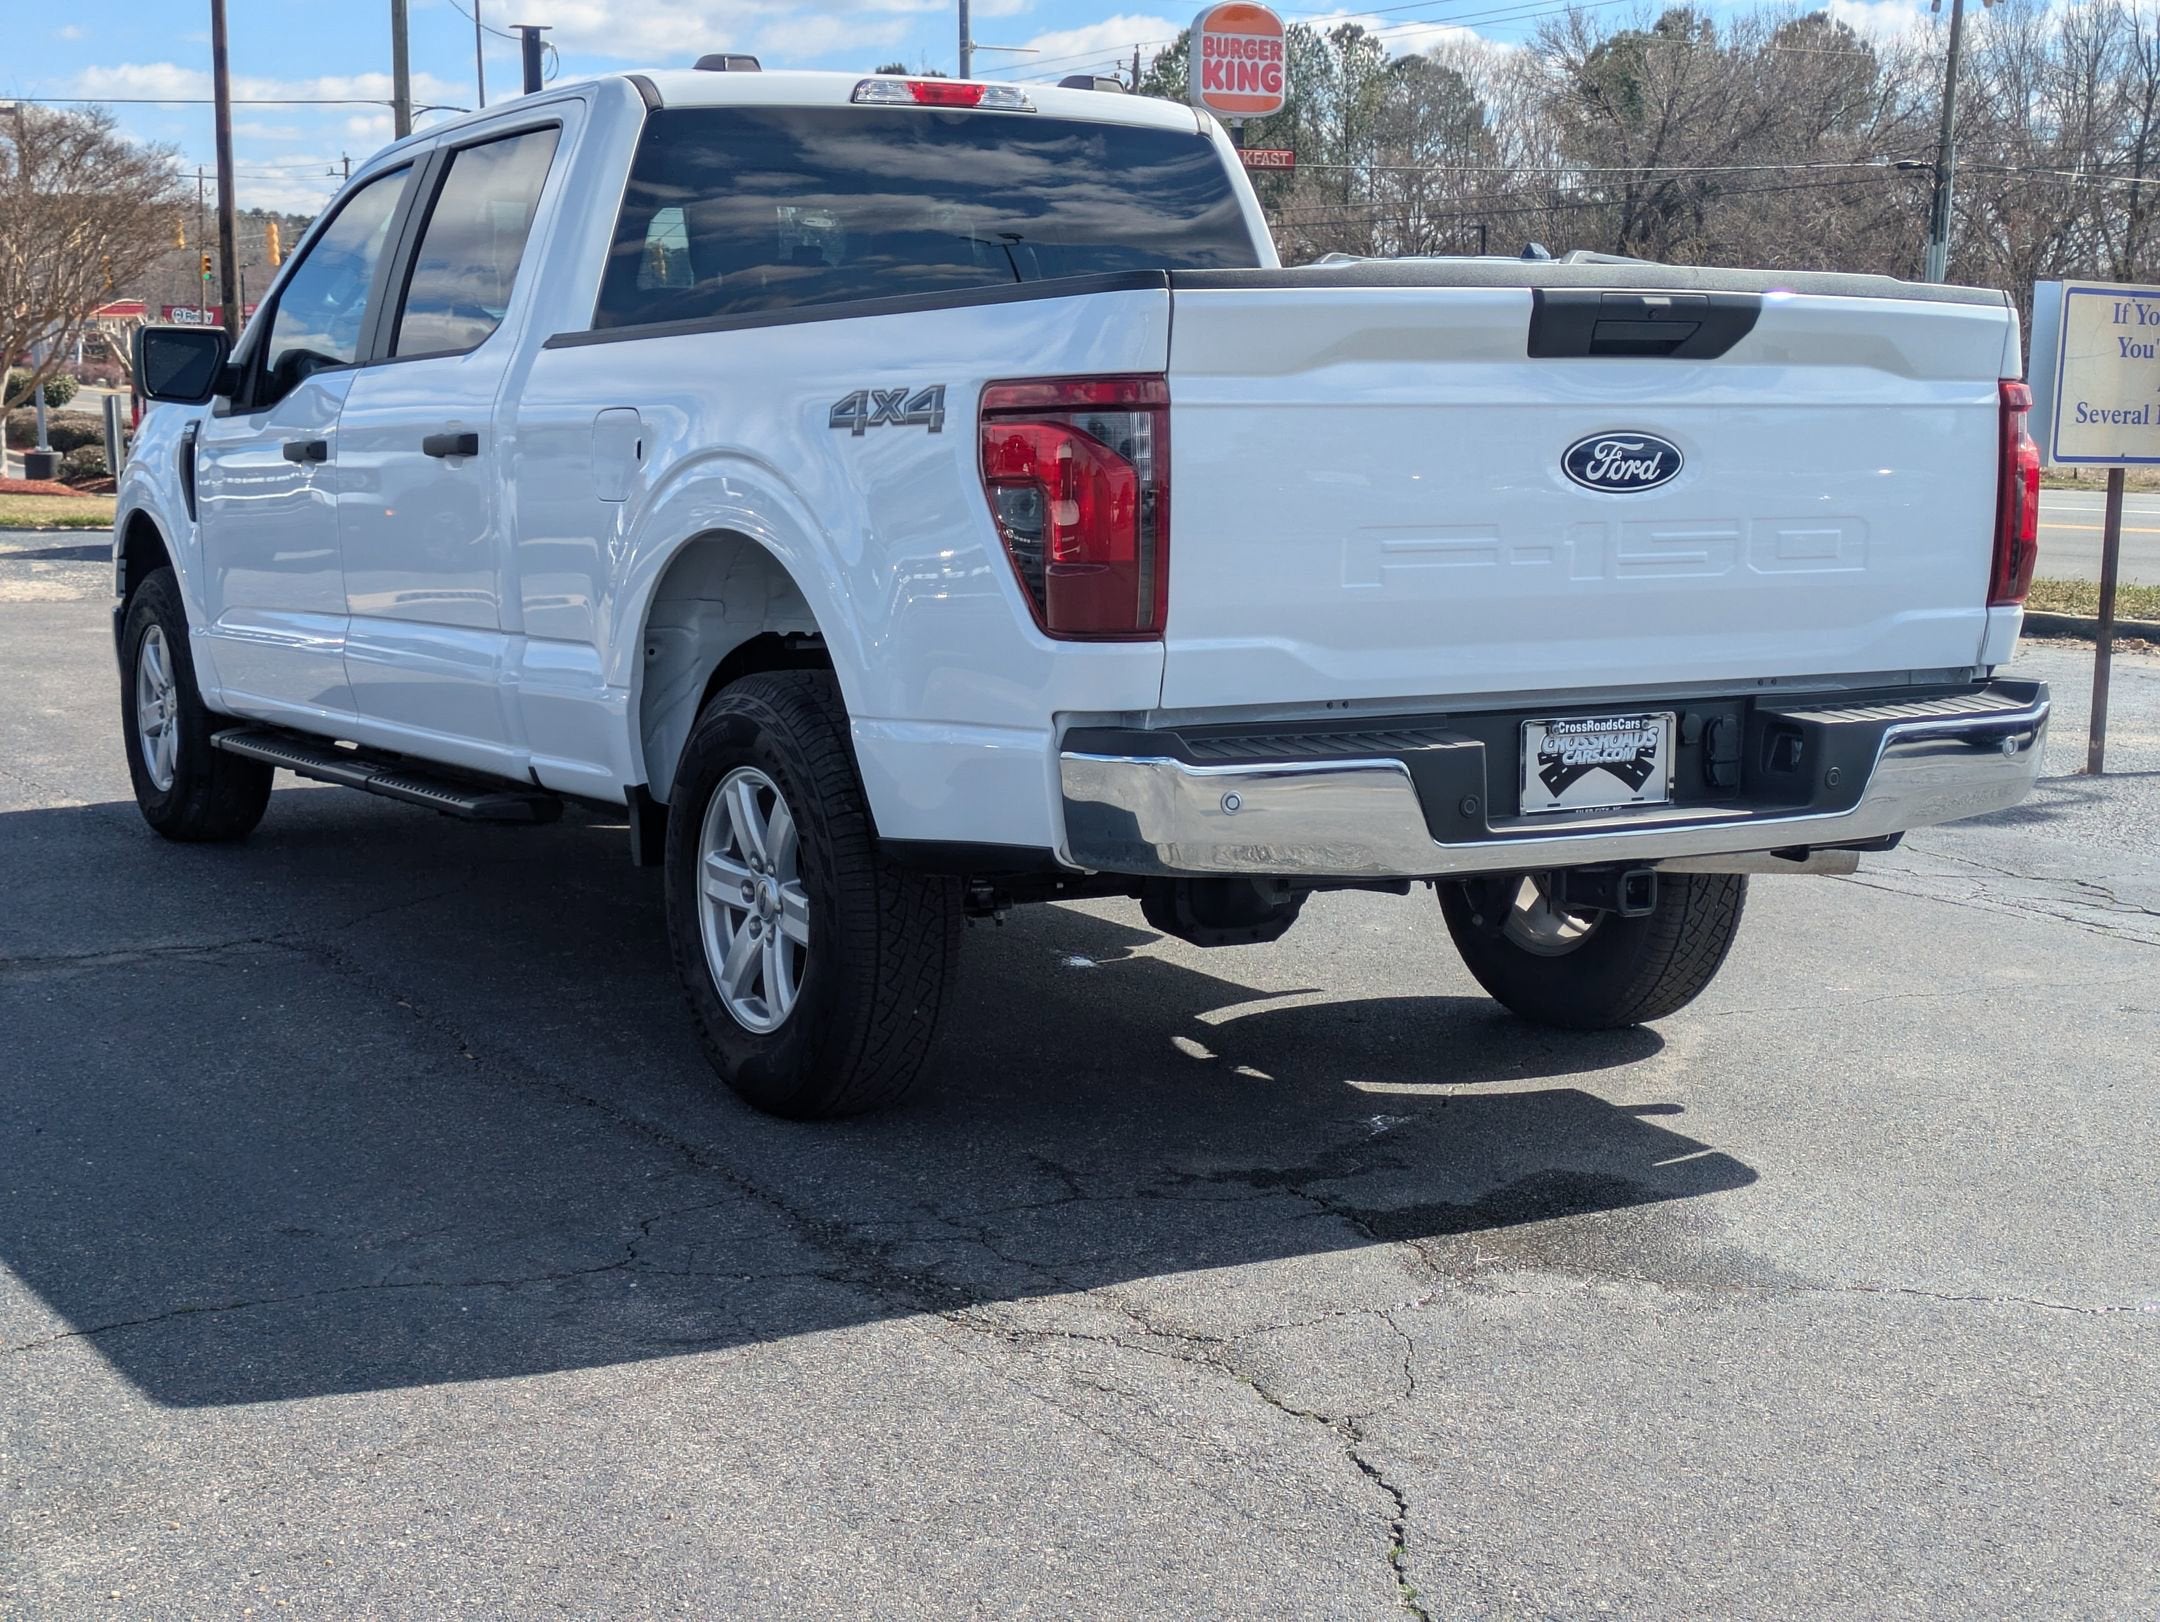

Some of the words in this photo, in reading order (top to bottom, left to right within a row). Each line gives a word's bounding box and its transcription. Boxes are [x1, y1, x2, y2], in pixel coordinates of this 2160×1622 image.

[1202, 36, 1283, 62] BURGER
[1202, 59, 1283, 93] KING
[2112, 302, 2131, 325] If
[2075, 401, 2149, 425] Several
[1586, 440, 1662, 480] Ford
[1341, 515, 1869, 588] F-150
[1558, 718, 1641, 734] CrossRoadsCars
[1562, 747, 1638, 765] CARS.COM
